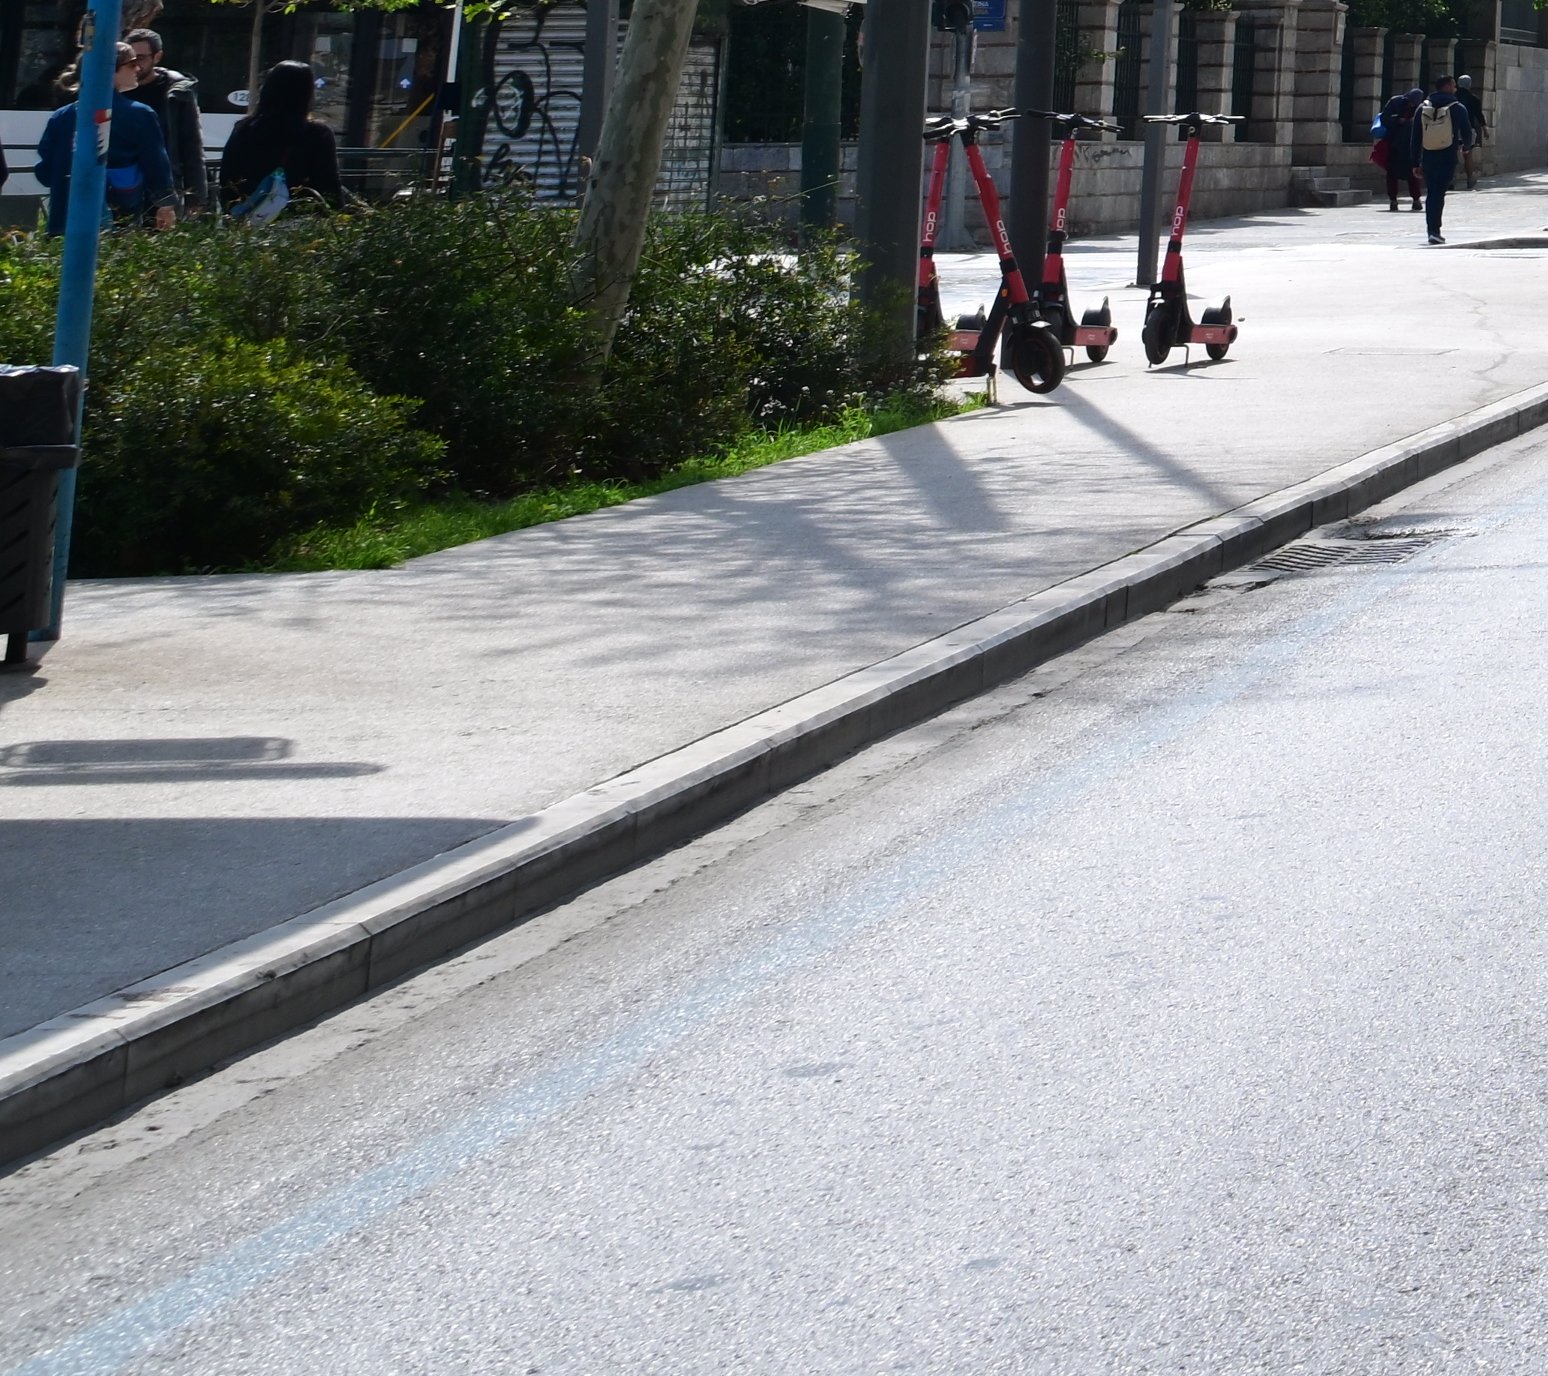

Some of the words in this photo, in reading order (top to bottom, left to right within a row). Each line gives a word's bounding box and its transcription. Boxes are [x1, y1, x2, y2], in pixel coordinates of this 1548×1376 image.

[922, 211, 937, 242] hop
[1171, 205, 1184, 236] hop
[996, 219, 1013, 254] hop
